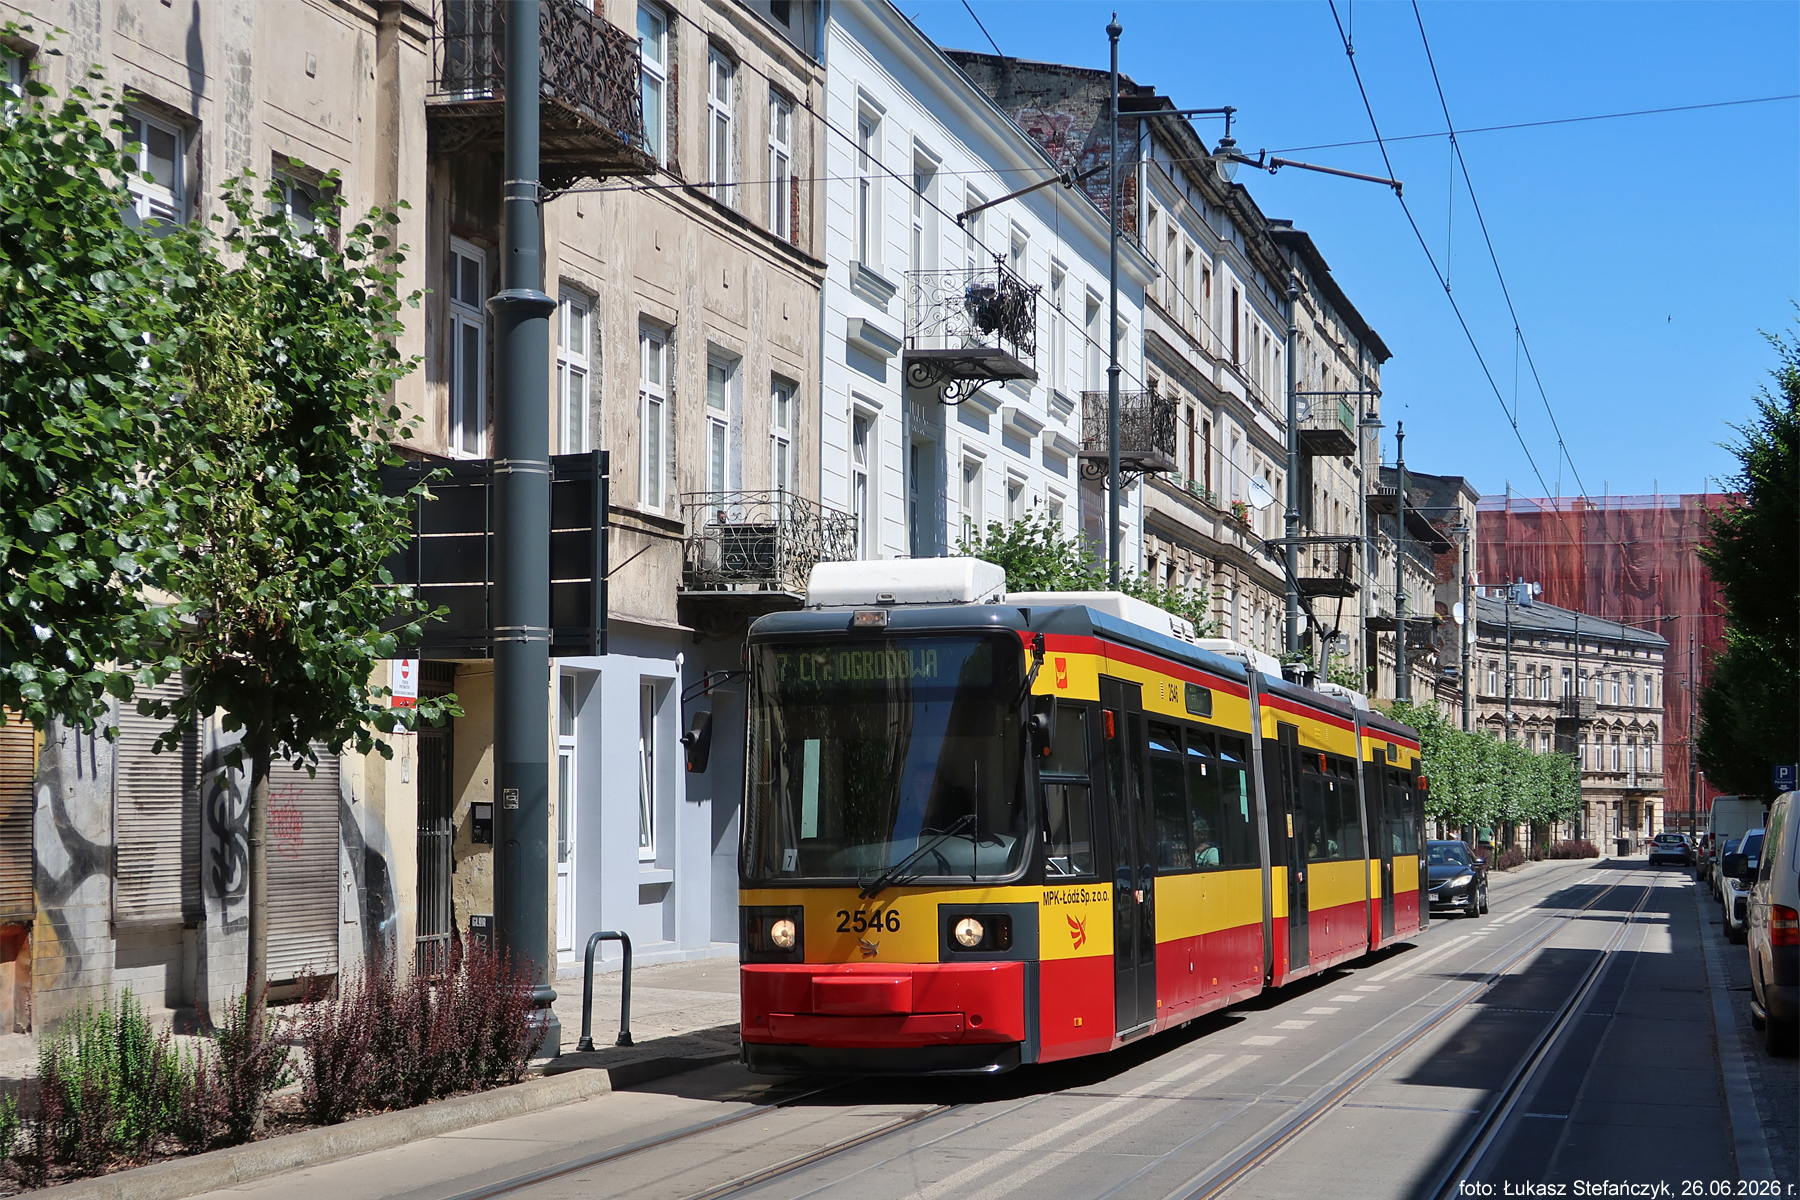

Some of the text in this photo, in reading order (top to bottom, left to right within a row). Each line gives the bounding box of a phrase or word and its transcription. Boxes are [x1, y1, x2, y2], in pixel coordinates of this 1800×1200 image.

[776, 653, 788, 682] 7
[839, 649, 938, 680] OGRODOWA
[1168, 683, 1179, 703] 2546
[1780, 768, 1788, 778] P
[787, 856, 793, 868] 7
[1043, 888, 1110, 906] MPK-Łódź Sp. z o.o.
[836, 909, 901, 933] 2546
